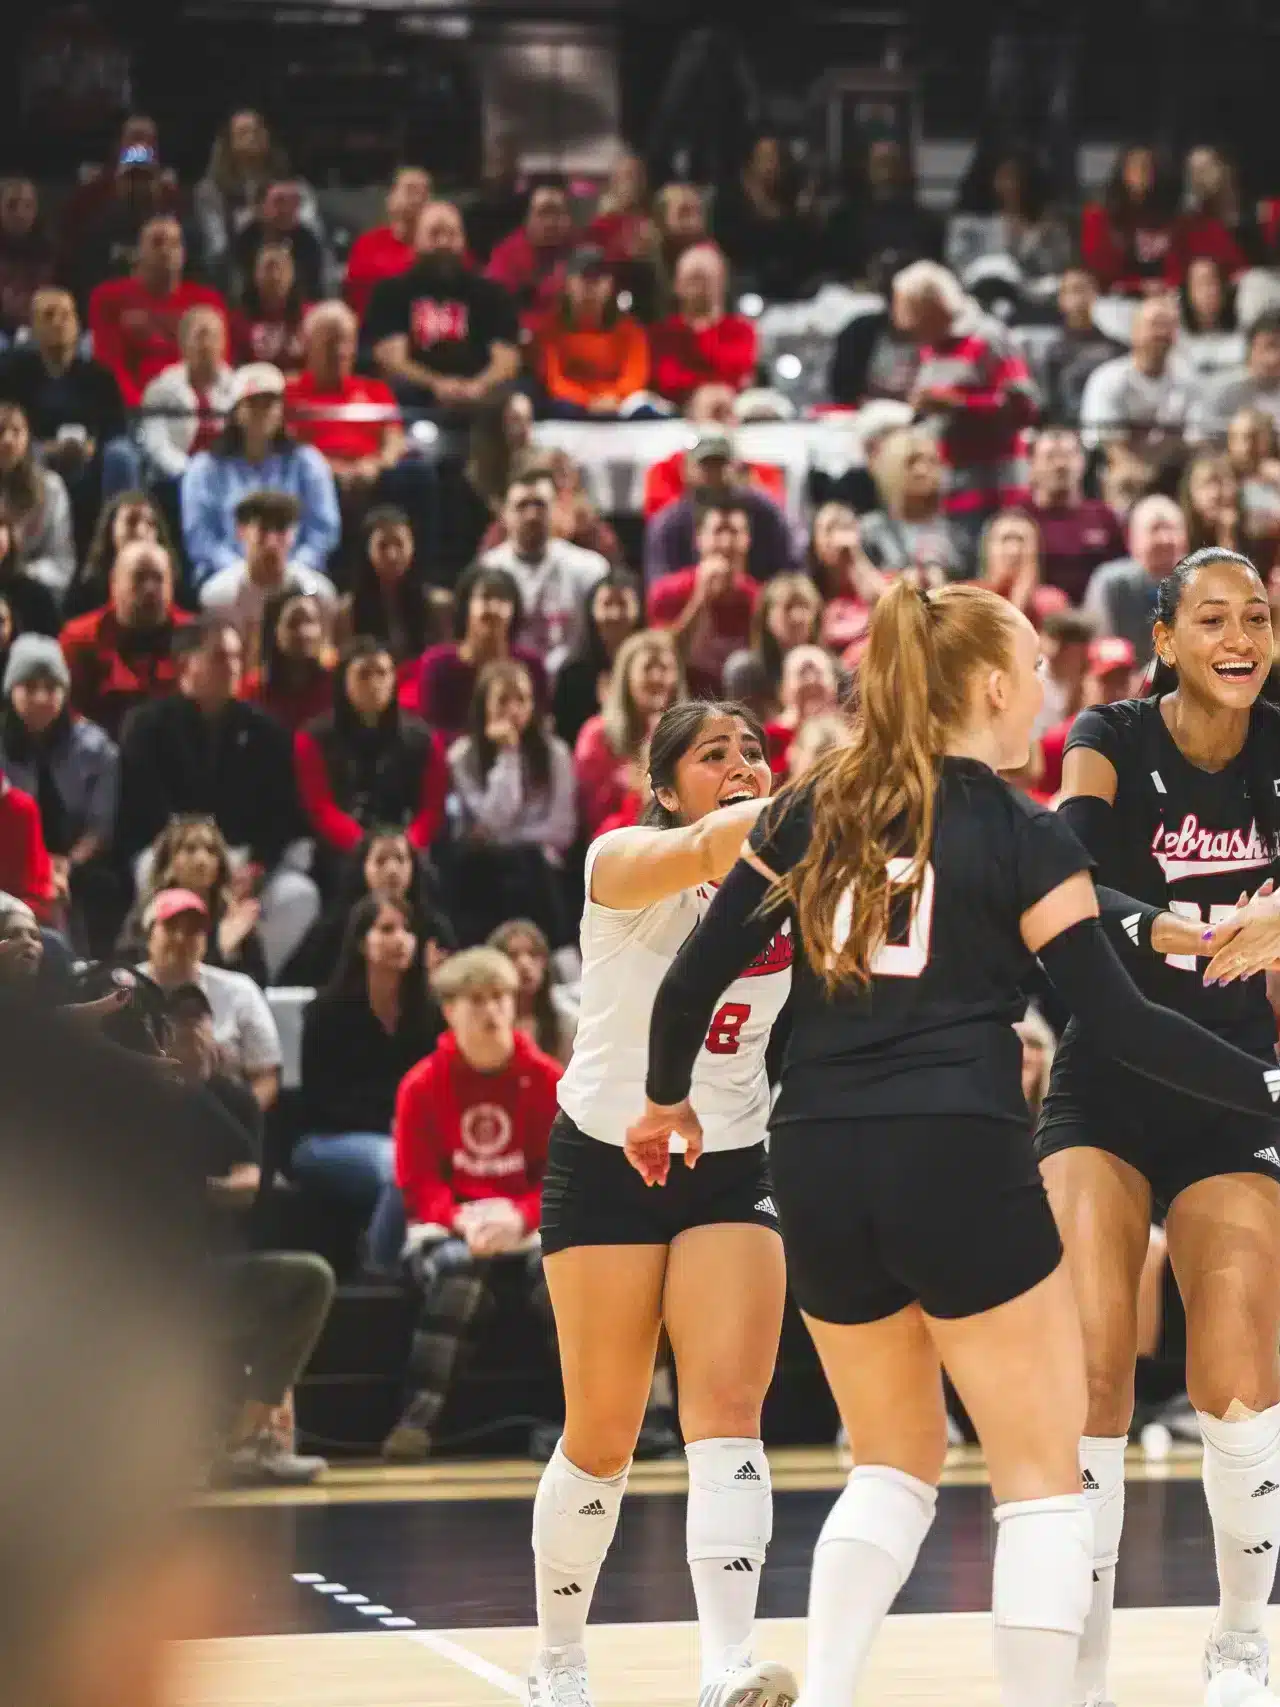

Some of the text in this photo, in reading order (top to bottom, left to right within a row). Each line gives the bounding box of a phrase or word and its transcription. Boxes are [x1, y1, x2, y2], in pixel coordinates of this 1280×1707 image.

[704, 1002, 751, 1055] 8
[733, 1472, 761, 1481] adidas
[1082, 1481, 1100, 1490] das
[1250, 1483, 1280, 1498] adidas
[578, 1507, 606, 1516] adidas
